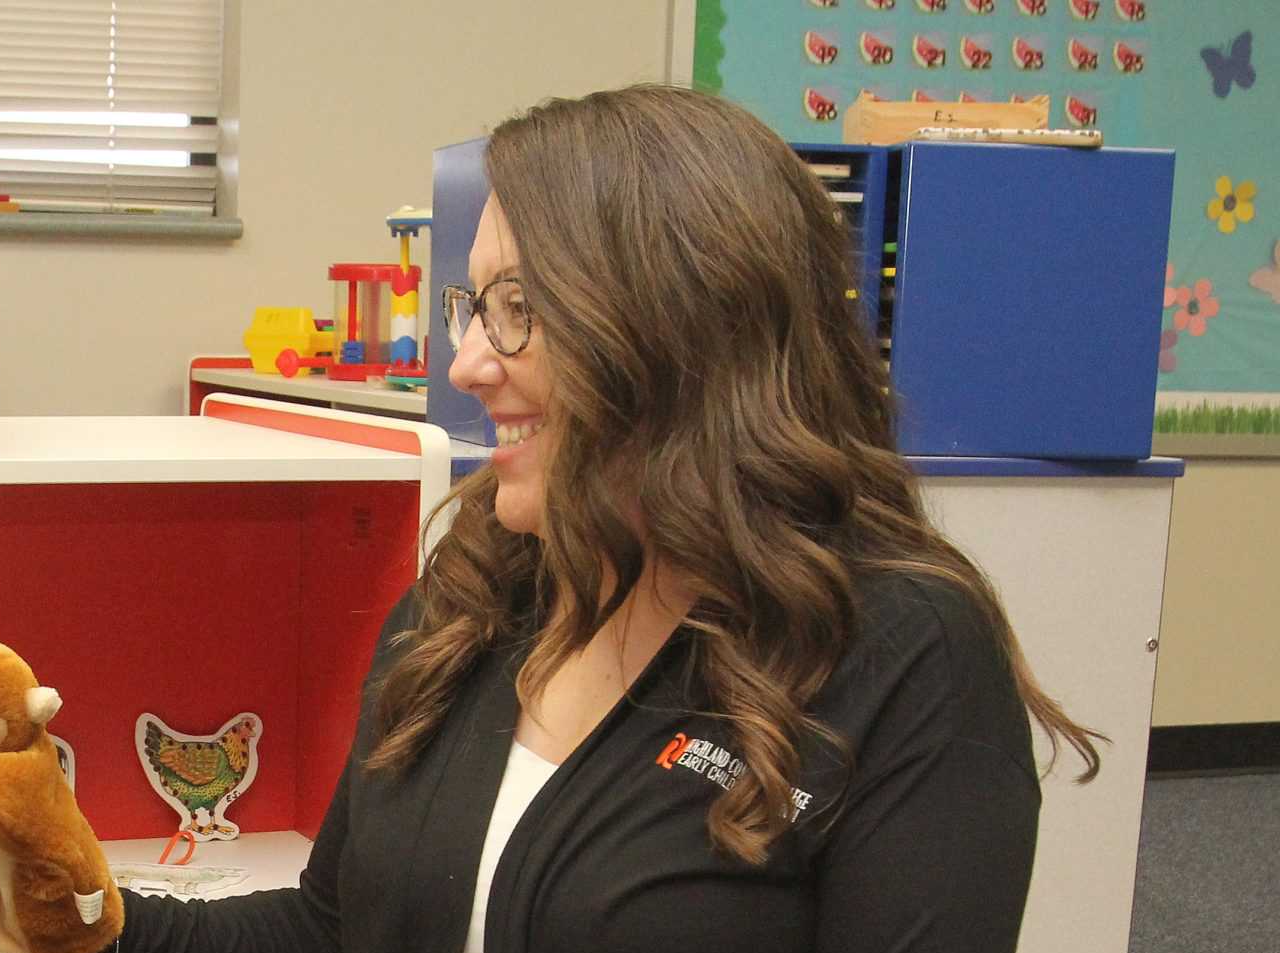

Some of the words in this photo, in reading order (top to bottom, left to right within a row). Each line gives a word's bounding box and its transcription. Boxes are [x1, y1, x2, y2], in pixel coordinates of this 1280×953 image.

[819, 47, 838, 64] 19
[872, 46, 893, 64] 20
[971, 50, 992, 69] 22
[1023, 50, 1044, 70] 23
[676, 752, 710, 774] EARLY
